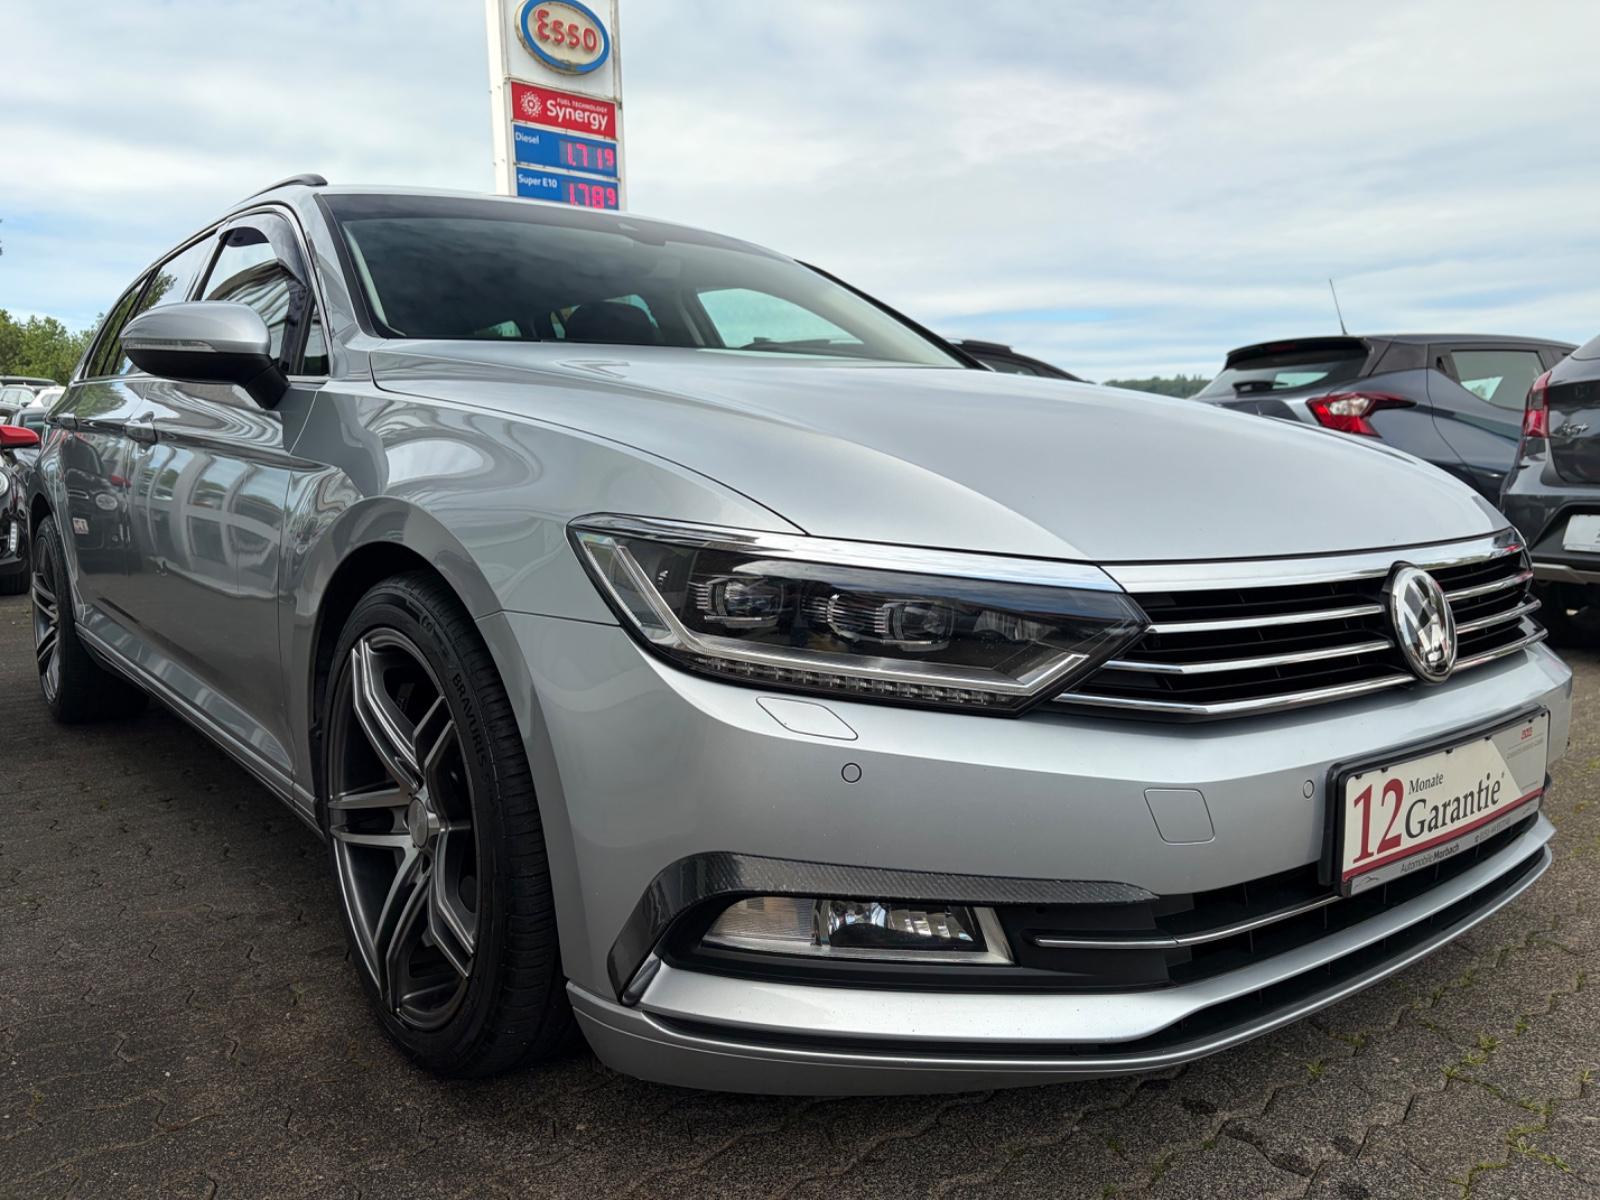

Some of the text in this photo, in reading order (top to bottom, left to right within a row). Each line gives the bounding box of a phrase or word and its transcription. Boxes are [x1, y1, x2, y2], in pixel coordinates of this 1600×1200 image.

[515, 132, 540, 144] Diesel
[547, 100, 608, 131] Synergy
[518, 174, 541, 187] Super
[542, 178, 558, 188] E10
[453, 673, 487, 767] BRAVURIS
[1353, 772, 1444, 864] 12 Monate
[1405, 772, 1501, 839] Garantie
